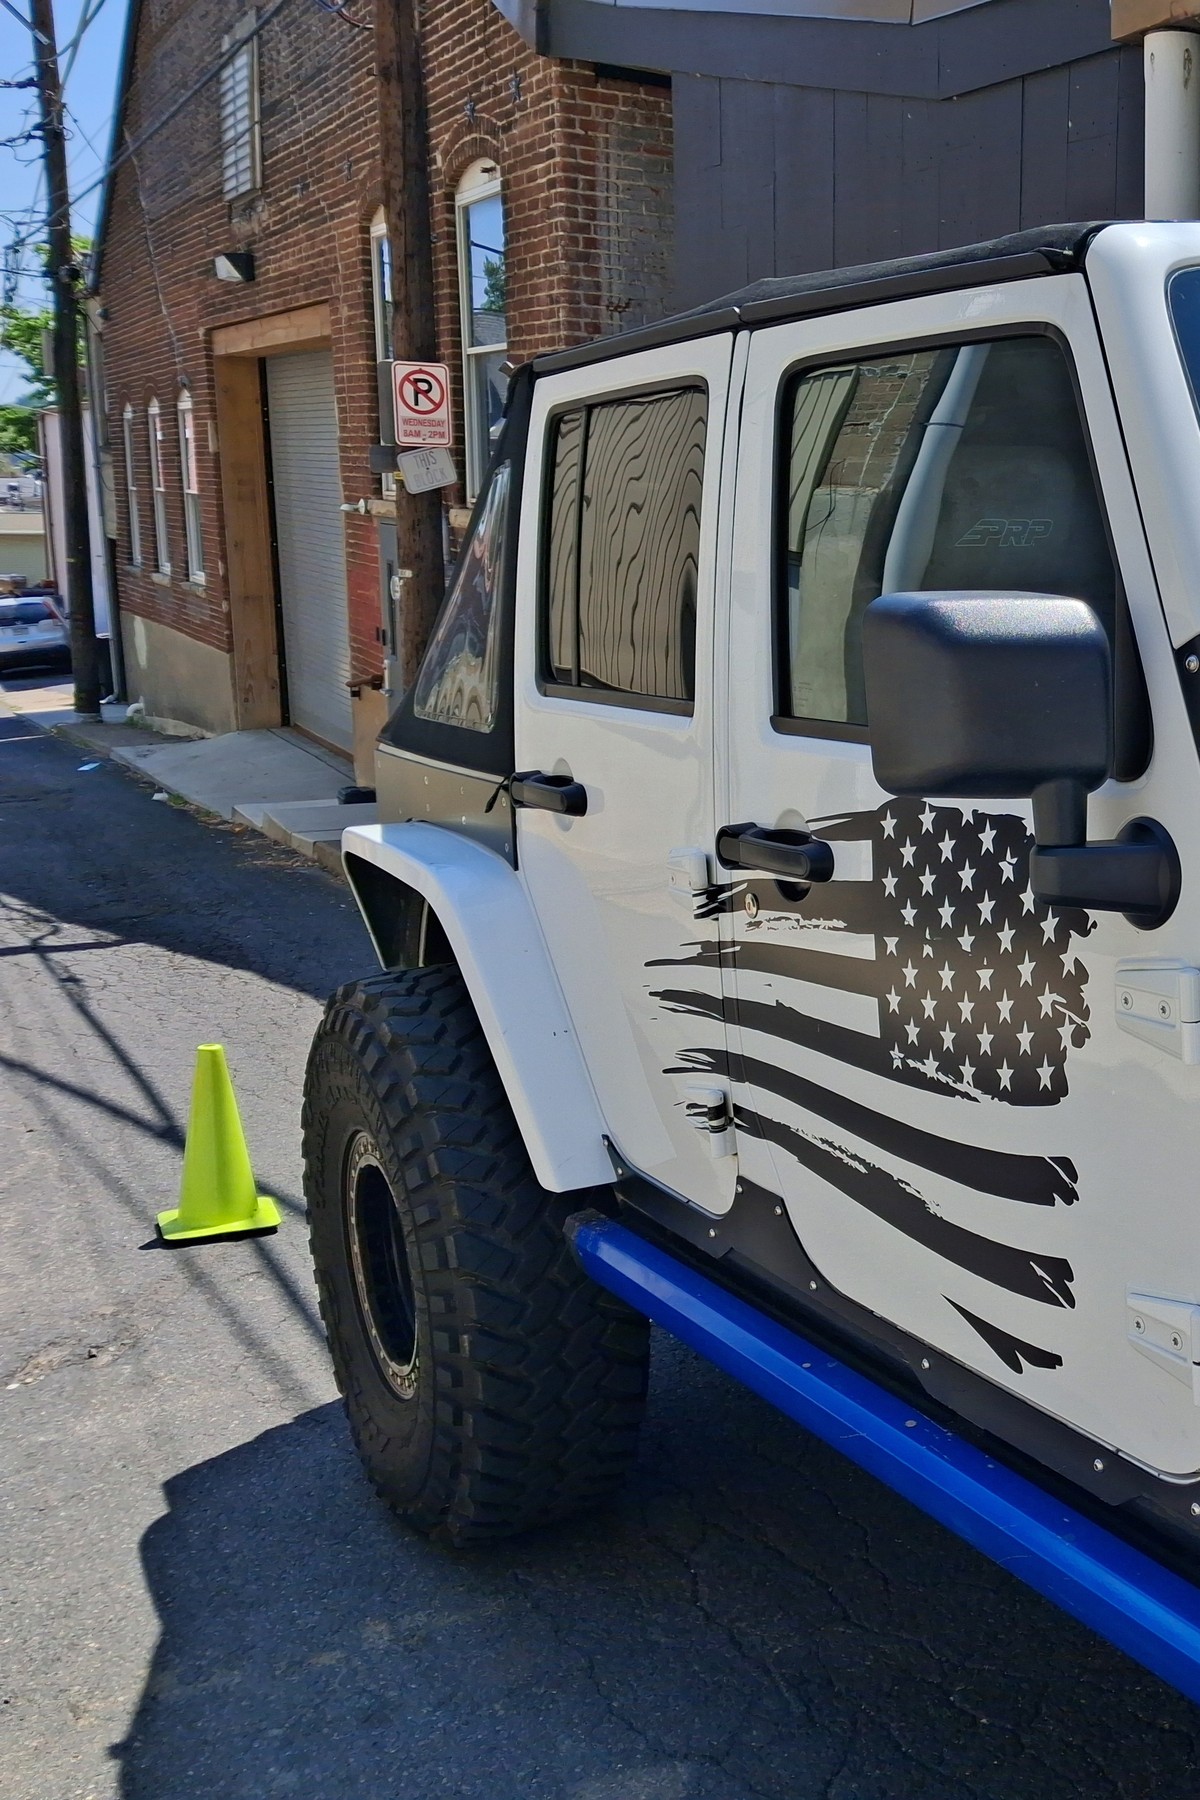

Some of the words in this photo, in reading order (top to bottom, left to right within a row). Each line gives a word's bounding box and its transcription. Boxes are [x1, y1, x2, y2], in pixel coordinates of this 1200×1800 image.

[402, 418, 446, 428] WEDNESDAY
[404, 429, 421, 438] 8AM
[428, 430, 446, 439] 2PM
[413, 450, 437, 469] THIS
[413, 467, 448, 489] BLOCK
